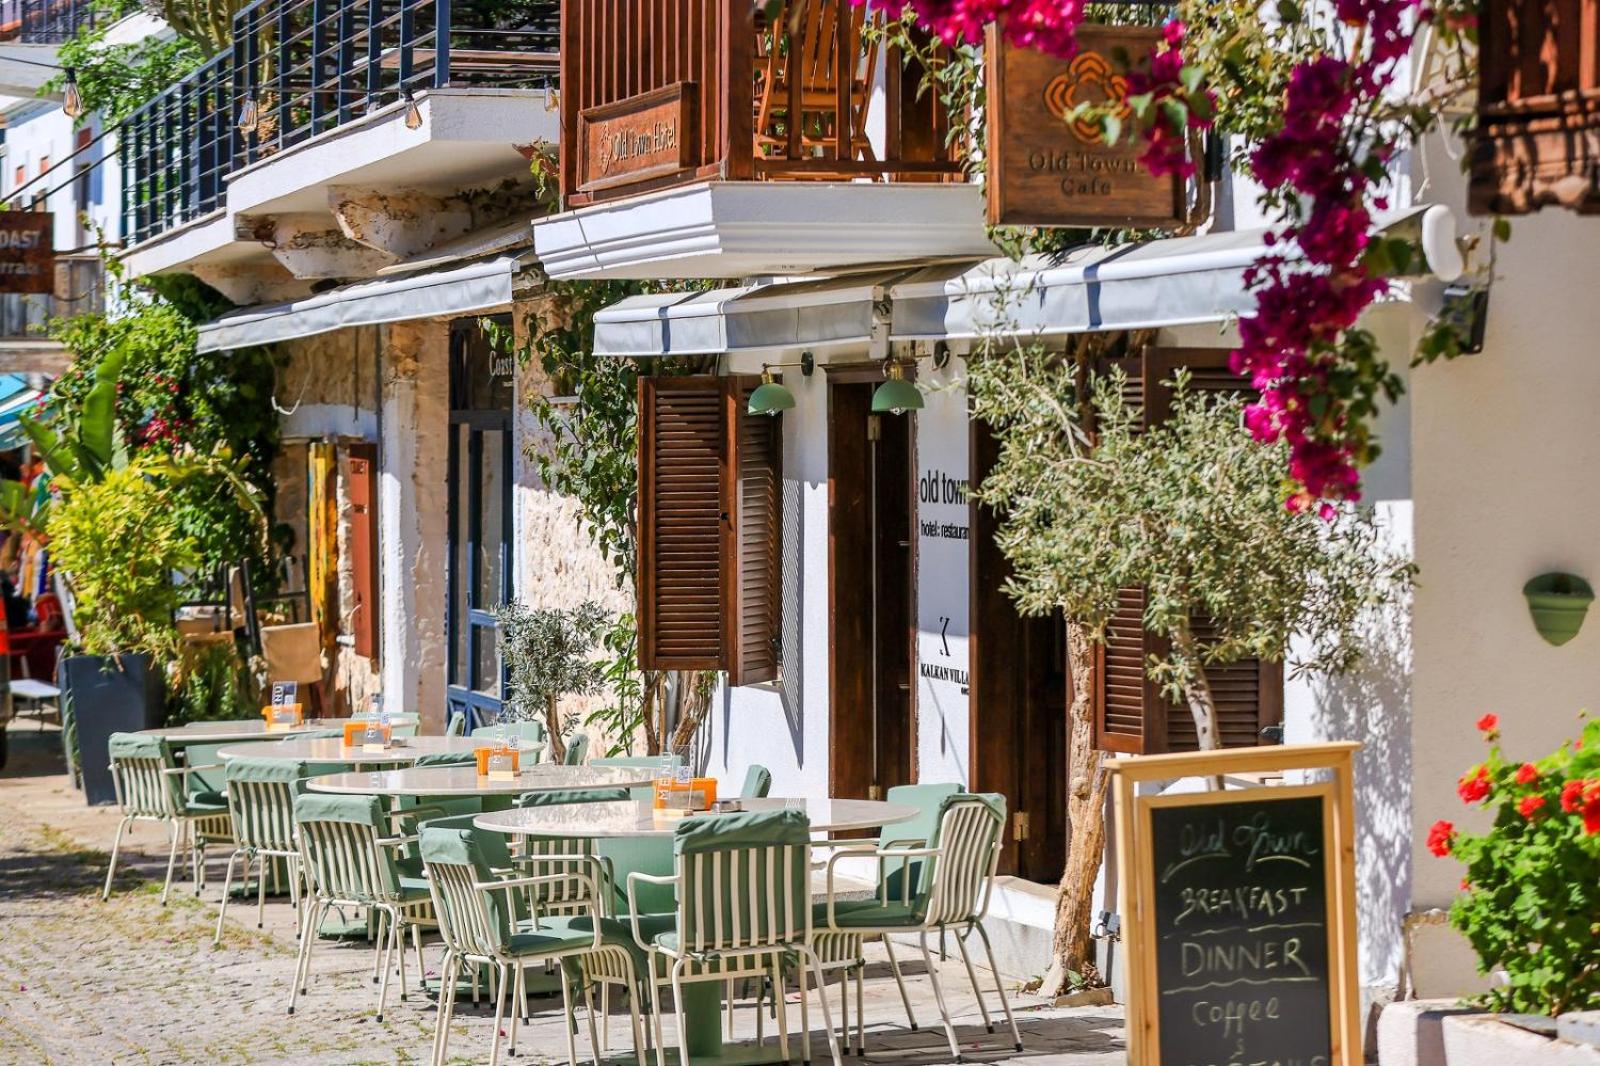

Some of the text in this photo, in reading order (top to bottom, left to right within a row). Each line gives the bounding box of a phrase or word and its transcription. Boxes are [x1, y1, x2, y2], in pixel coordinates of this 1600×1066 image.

[611, 115, 678, 162] Old Town Hotel
[1028, 151, 1139, 174] Old Town
[1061, 177, 1112, 197] Cafe
[488, 350, 513, 377] Coast
[920, 469, 939, 503] old
[920, 663, 949, 681] KALKAN
[1179, 818, 1230, 857] Old
[1174, 886, 1309, 926] BREAKFAST
[1181, 937, 1311, 978] DINNER
[1191, 997, 1281, 1039] Coffee
